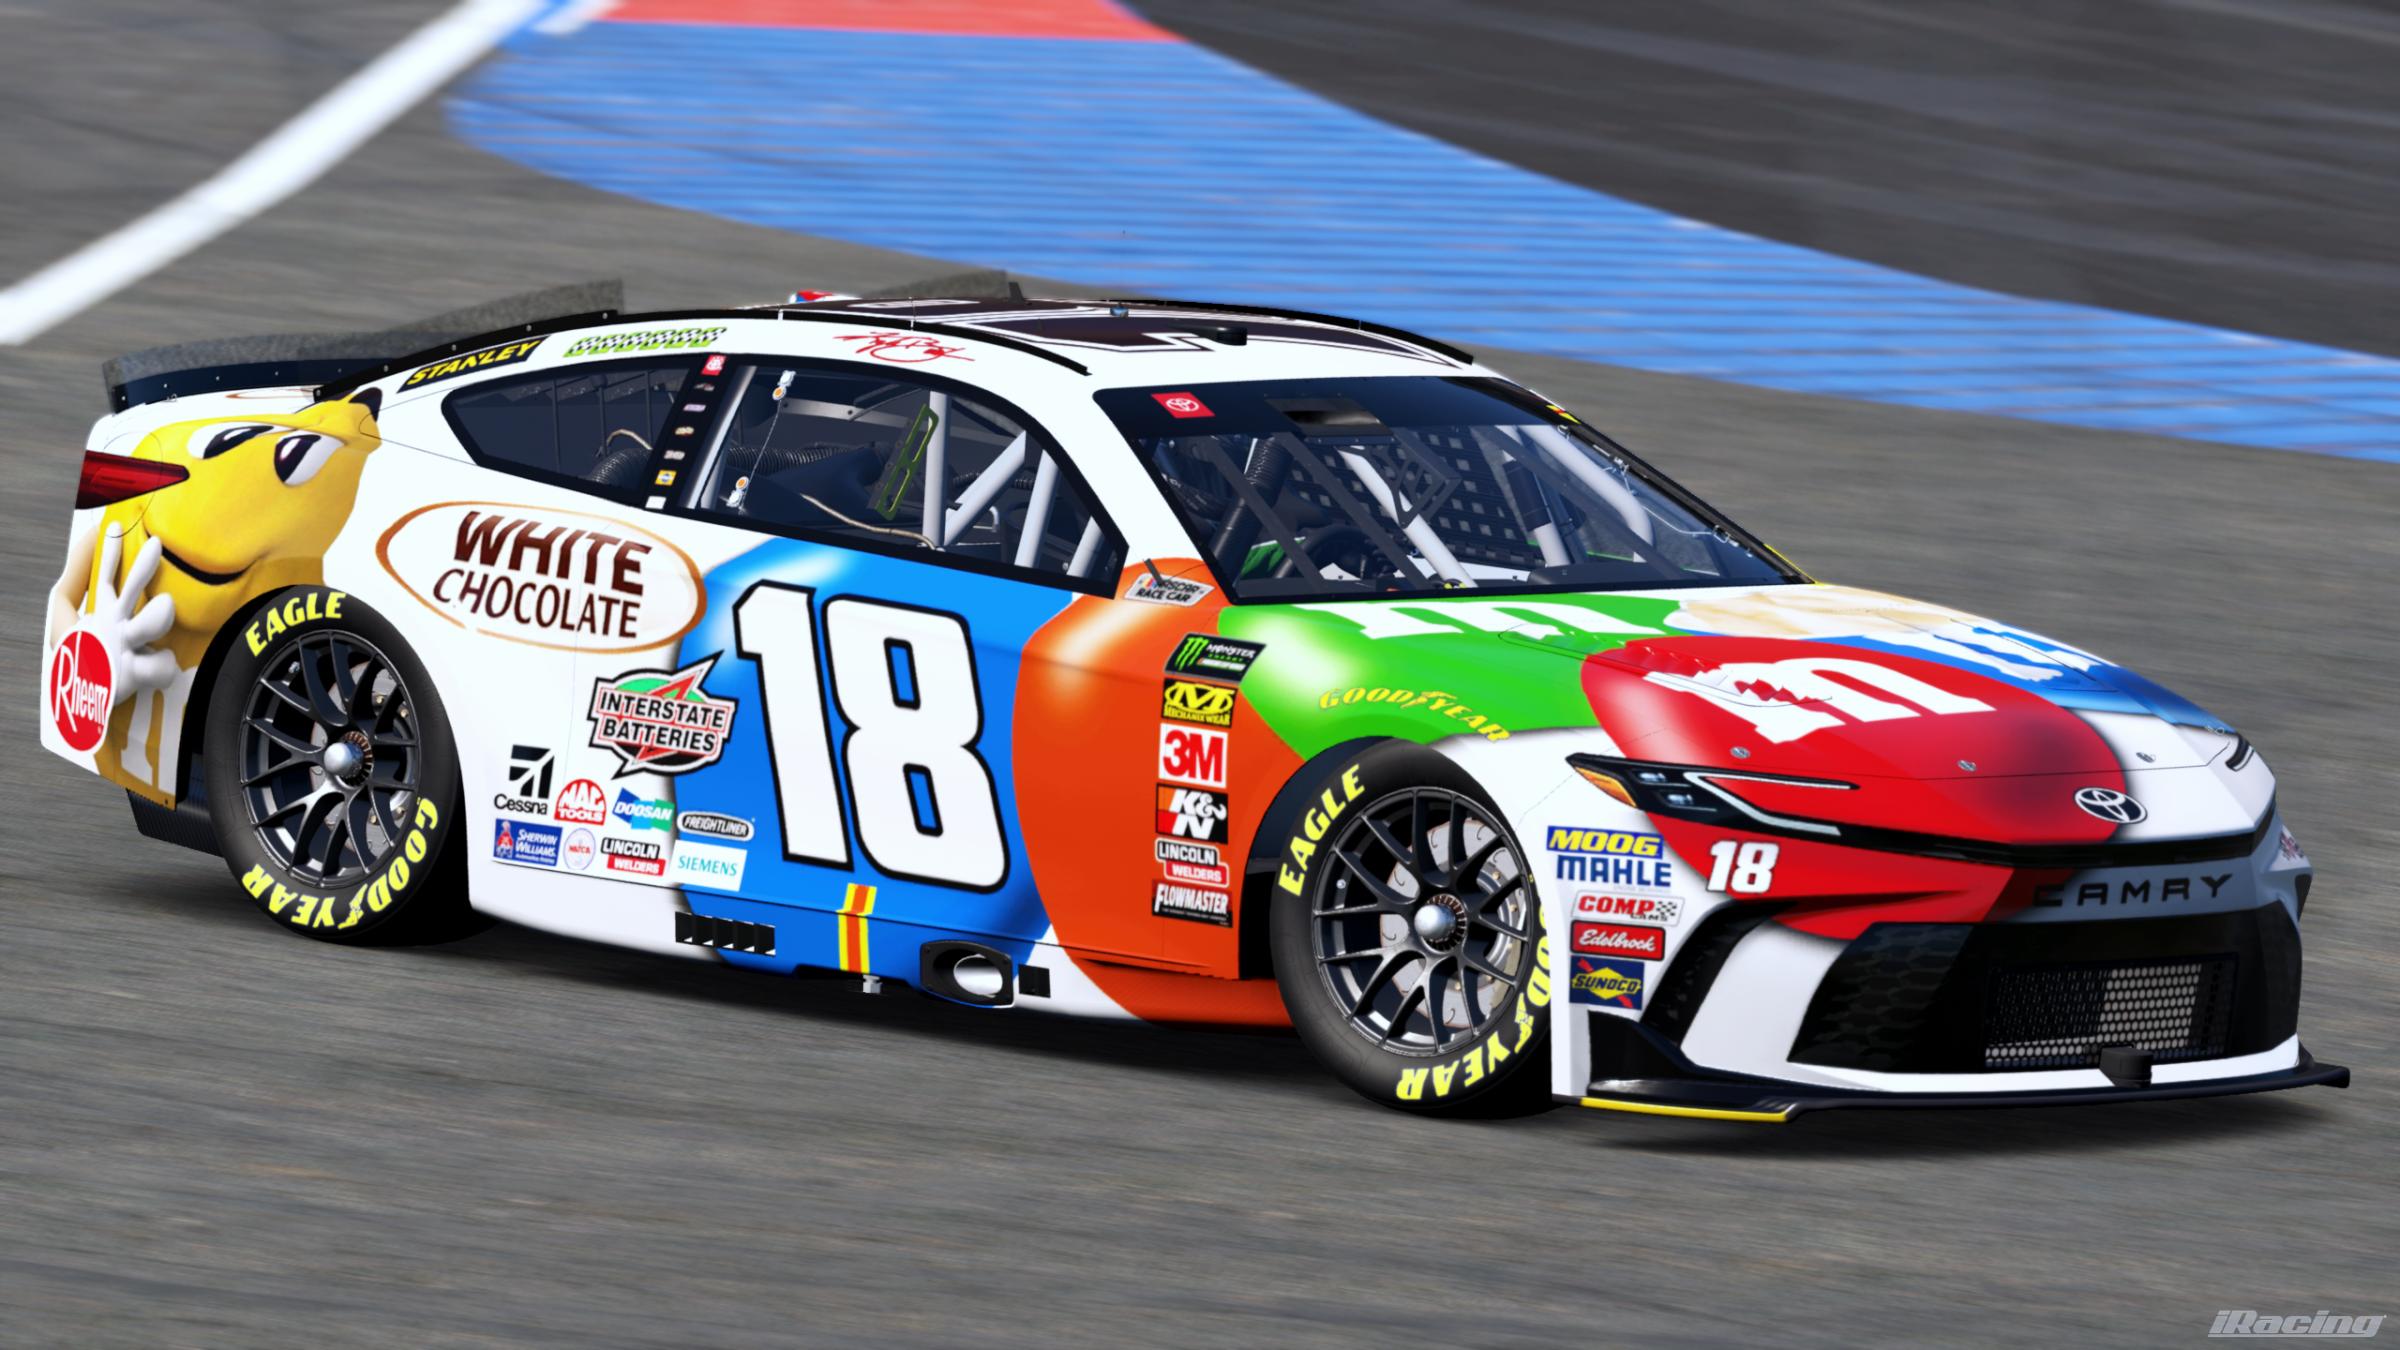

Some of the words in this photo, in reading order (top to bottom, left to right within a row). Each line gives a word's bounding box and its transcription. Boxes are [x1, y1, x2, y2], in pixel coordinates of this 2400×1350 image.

[406, 340, 542, 385] STANLEY
[454, 511, 652, 596] WHITE
[1136, 588, 1165, 600] RACE
[1166, 591, 1191, 602] CAR
[1156, 578, 1200, 593] ASCAR
[433, 569, 640, 638] CHOCOLATE
[245, 592, 346, 656] EAGLE
[1206, 644, 1256, 658] MONSTER
[54, 631, 108, 732] Rheem
[601, 691, 726, 728] INTERSTATE
[1319, 687, 1510, 743] GOODYEAR
[603, 718, 716, 752] BATTERIES
[732, 579, 1011, 895] 18
[1163, 730, 1224, 783] 3M
[494, 793, 548, 815] Cessna
[559, 780, 604, 809] MAC
[558, 808, 603, 822] TOOLS
[615, 801, 673, 821] DOOSAN
[684, 815, 748, 836] FREIGHTLINER
[1278, 764, 1365, 896] EAGLE
[1550, 829, 1660, 856] MOOG
[603, 838, 658, 857] LINCOLN
[1158, 842, 1215, 866] LINCOLN
[242, 797, 438, 929] GOODYEAR
[614, 857, 660, 875] WELDERS
[678, 855, 738, 876] SIEMENS
[1172, 864, 1222, 882] WELDERS
[1556, 855, 1672, 887] MAHLE
[1706, 840, 1779, 893] 18
[1154, 883, 1229, 914] FLOWMASTER
[2032, 873, 2232, 907] CAMRY
[1578, 895, 1655, 916] COMP
[1579, 929, 1656, 952] Edelbrock
[1574, 974, 1640, 993] SUNOCO
